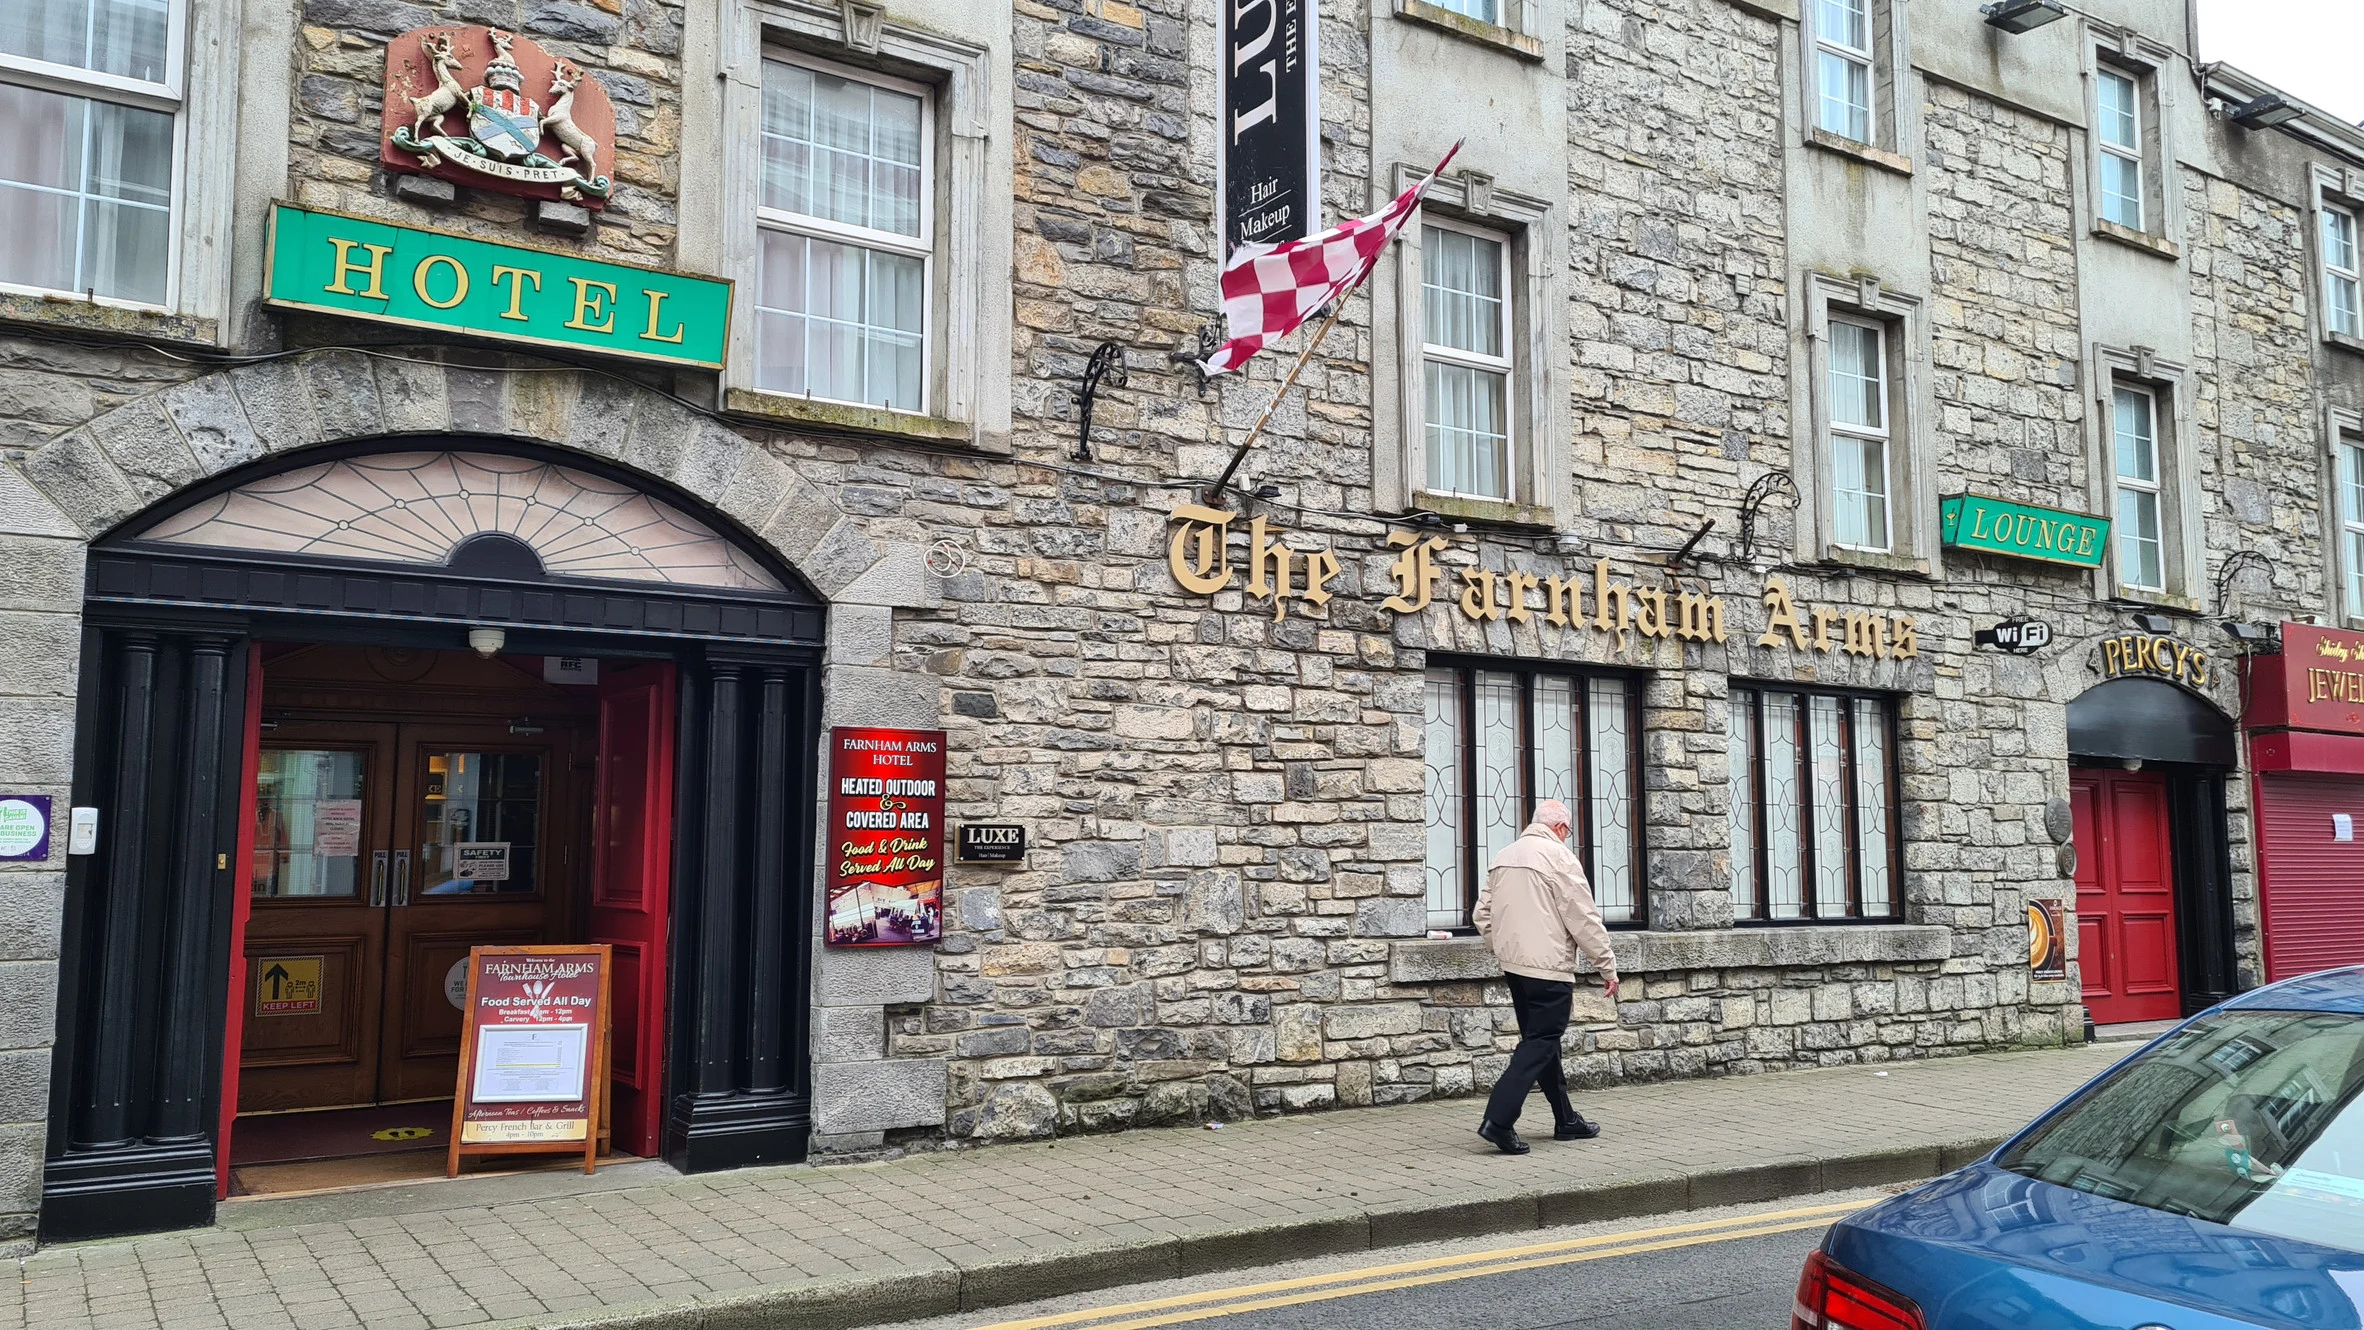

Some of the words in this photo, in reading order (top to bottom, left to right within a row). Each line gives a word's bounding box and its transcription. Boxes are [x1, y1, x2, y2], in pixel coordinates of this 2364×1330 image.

[1286, 18, 1297, 73] THE
[454, 152, 469, 163] JE
[480, 161, 512, 176] SUIS
[524, 170, 558, 179] PRET
[1250, 176, 1278, 204] Hair
[1240, 205, 1290, 240] Makeup
[323, 237, 684, 345] HOTEL
[1970, 508, 2097, 557] LOUNGE
[1168, 504, 1342, 623] The
[1380, 531, 1730, 653] Farnham
[1756, 576, 1919, 660] Arms
[2103, 636, 2206, 686] PERCY'S
[843, 738, 902, 751] FARNHAM
[905, 741, 937, 753] ARMS
[873, 754, 913, 766] HOTEL
[841, 777, 883, 795] HEATED
[886, 778, 936, 797] OUTDOOR
[879, 793, 907, 811] &
[846, 811, 897, 829] COVERED
[900, 812, 929, 829] AREA
[967, 827, 1019, 844] LUXE
[841, 841, 875, 857] Food
[877, 838, 888, 854] &
[889, 837, 928, 854] Drink
[839, 859, 882, 877] Served
[883, 856, 905, 873] All
[907, 854, 936, 871] Day
[485, 963, 553, 974] FARNHAM
[556, 962, 594, 973] ARMS
[498, 971, 549, 982] Townhouse
[549, 967, 580, 981] Hotel
[262, 1002, 289, 1010] KEEP
[291, 1001, 315, 1009] LEFT
[481, 997, 510, 1007] Food
[512, 996, 551, 1006] Served
[553, 996, 568, 1006] All
[570, 996, 592, 1008] Day
[498, 1008, 530, 1016] Breakfast
[555, 1008, 573, 1016] 12pm
[535, 1015, 553, 1023] 12pm
[467, 1108, 503, 1120] Afternoon
[504, 1107, 520, 1116] Teas
[526, 1105, 551, 1118] Coffees
[552, 1105, 559, 1113] &
[560, 1103, 586, 1113] Snacks
[476, 1122, 498, 1133] Percy
[500, 1122, 527, 1132] French
[545, 1122, 553, 1130] &
[556, 1120, 575, 1130] Grill
[505, 1130, 520, 1138] 4pm
[527, 1130, 544, 1138] 10pm
